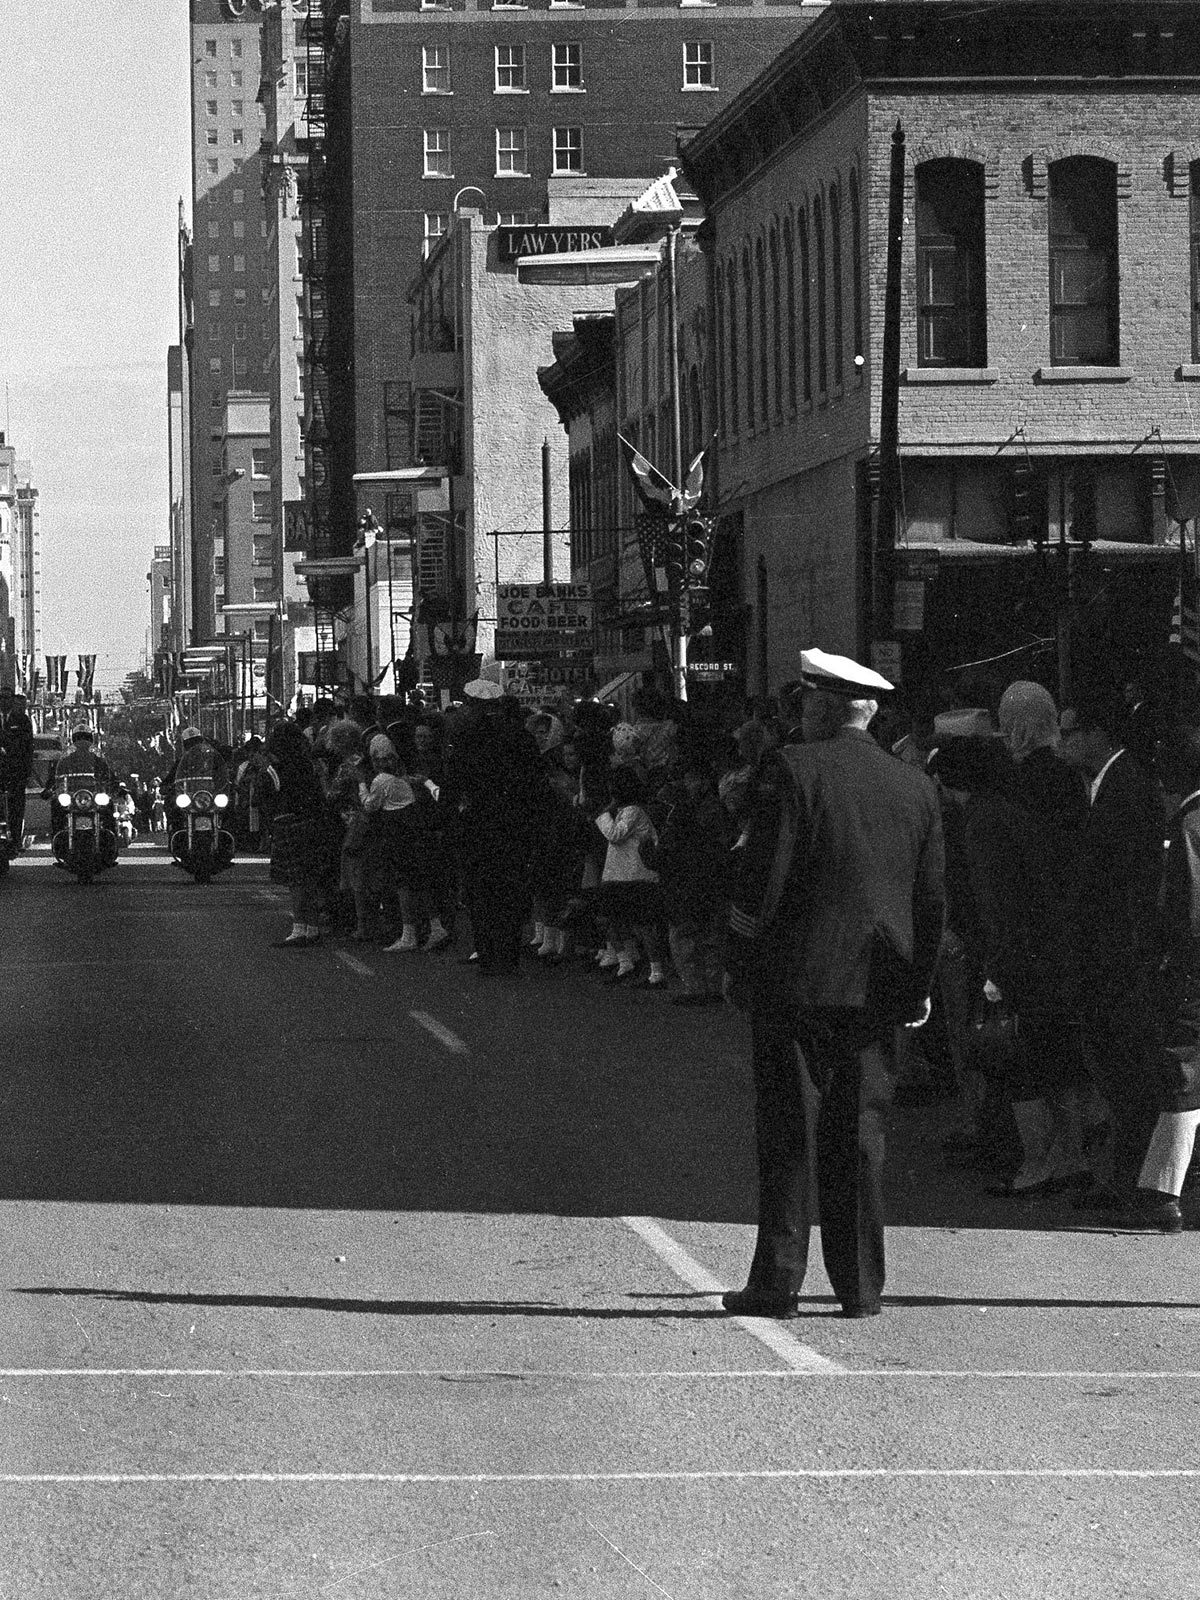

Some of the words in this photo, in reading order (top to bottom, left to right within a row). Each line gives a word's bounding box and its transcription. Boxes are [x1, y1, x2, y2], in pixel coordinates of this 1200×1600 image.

[508, 232, 602, 254] LAWYERS
[500, 586, 530, 599] JOE
[501, 616, 540, 629] FOOD
[548, 615, 588, 628] BEER
[689, 663, 719, 671] RECORD
